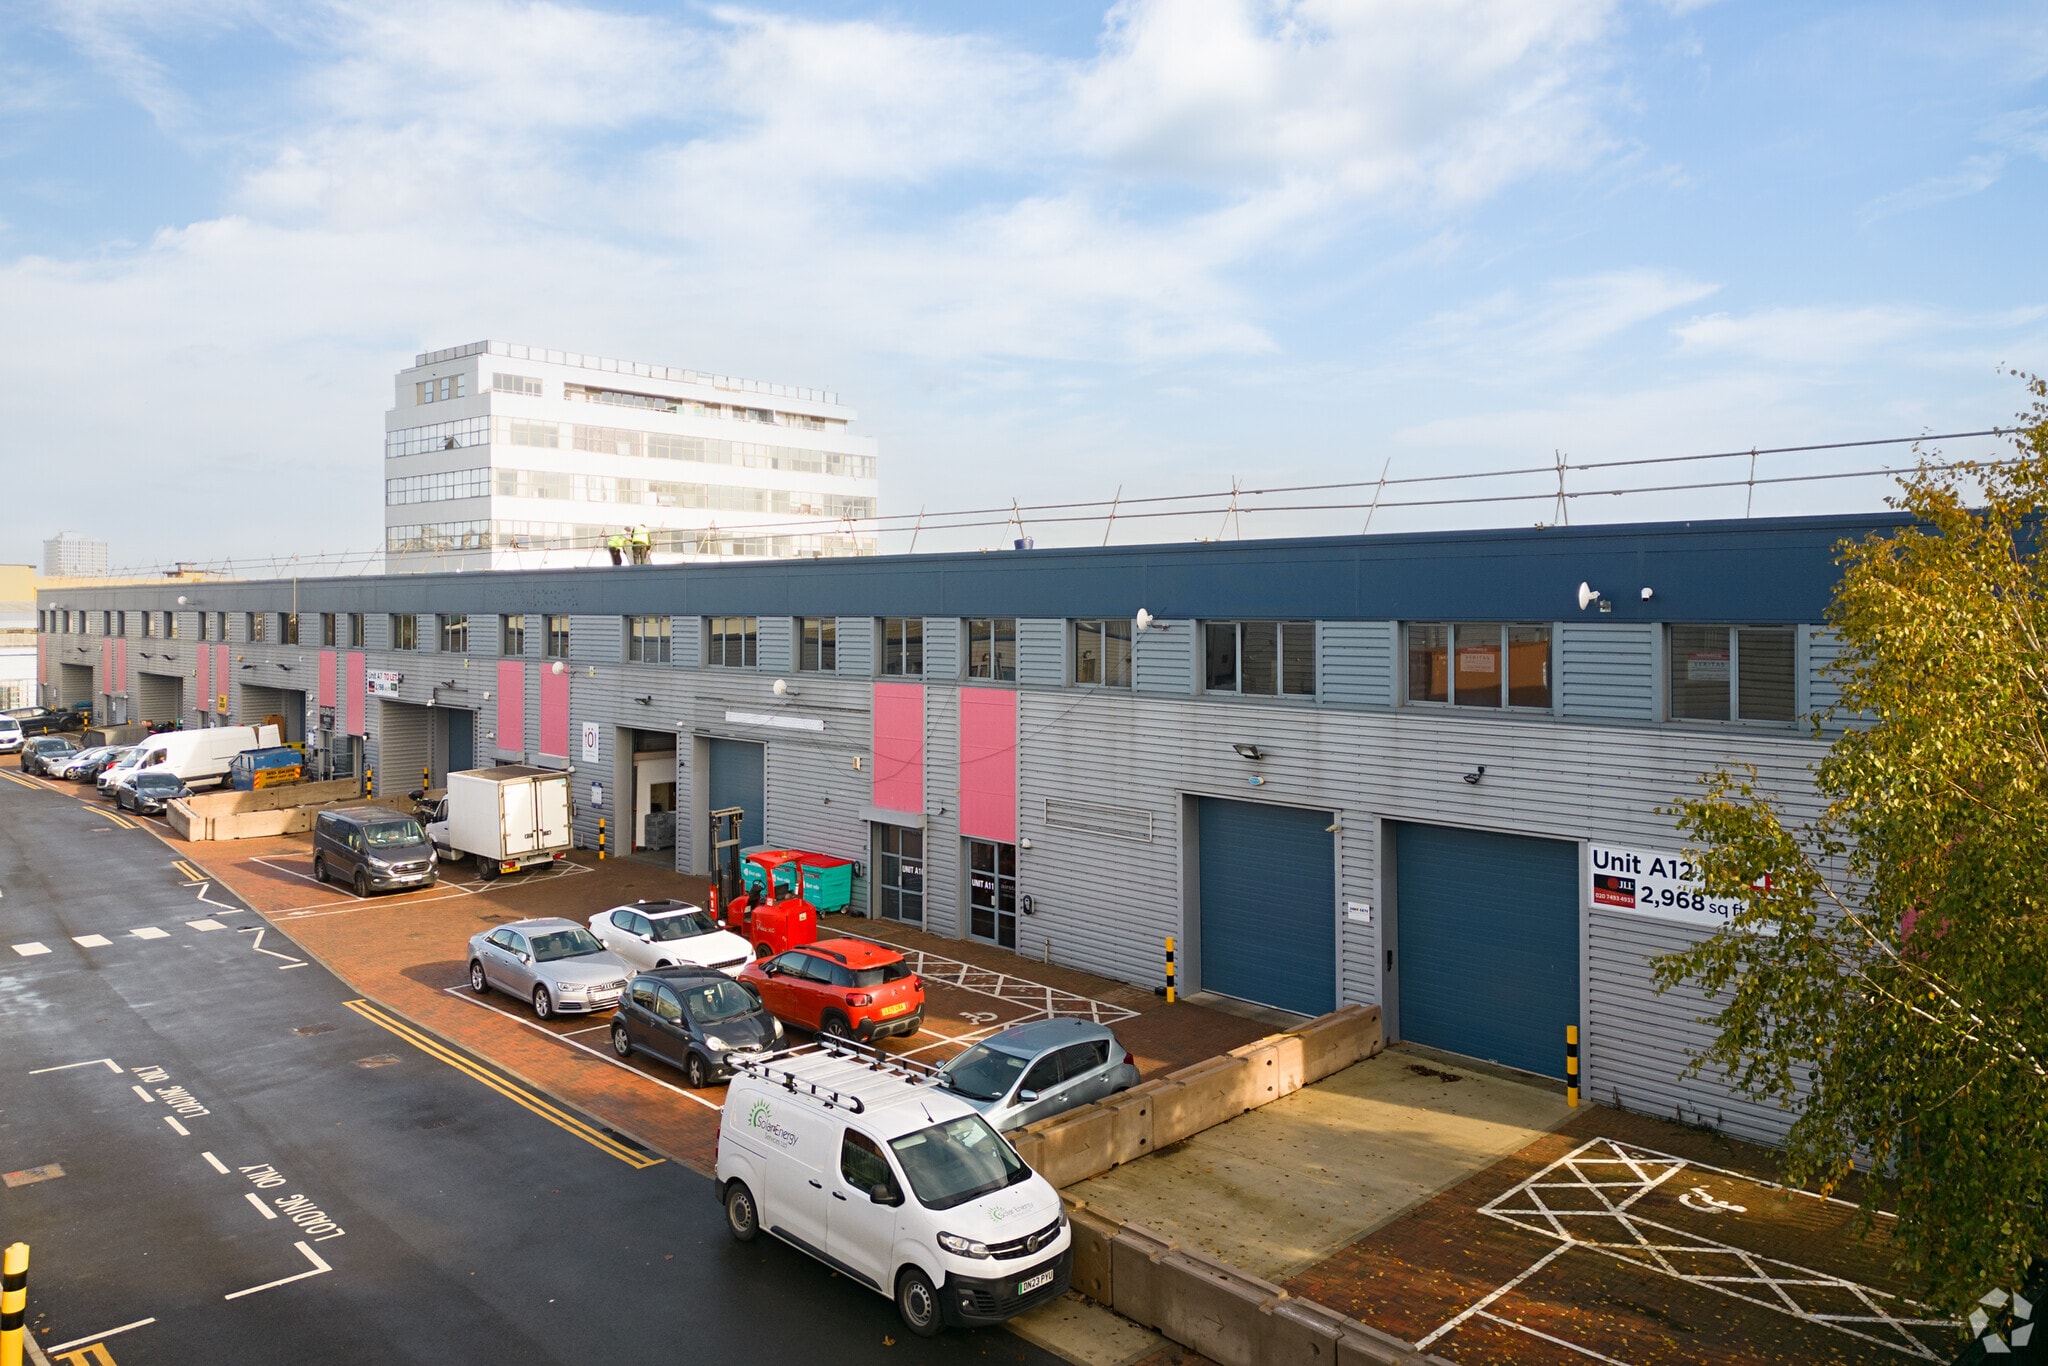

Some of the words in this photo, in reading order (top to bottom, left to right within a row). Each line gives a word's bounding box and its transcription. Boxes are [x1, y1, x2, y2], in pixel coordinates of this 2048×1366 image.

[1594, 850, 1641, 875] Unit
[1649, 857, 1694, 882] A12
[971, 878, 983, 887] UNIT
[984, 881, 994, 890] A11
[1618, 880, 1634, 890] JLL
[1641, 886, 1705, 912] 2,968
[1709, 903, 1728, 918] sq
[1732, 904, 1745, 917] ft
[131, 1065, 170, 1083] ONLY
[155, 1085, 211, 1118] LOADING
[238, 1163, 287, 1189] ONLY
[274, 1193, 346, 1242] LOADING
[1023, 1277, 1040, 1291] DN23
[1040, 1270, 1053, 1284] PYU
